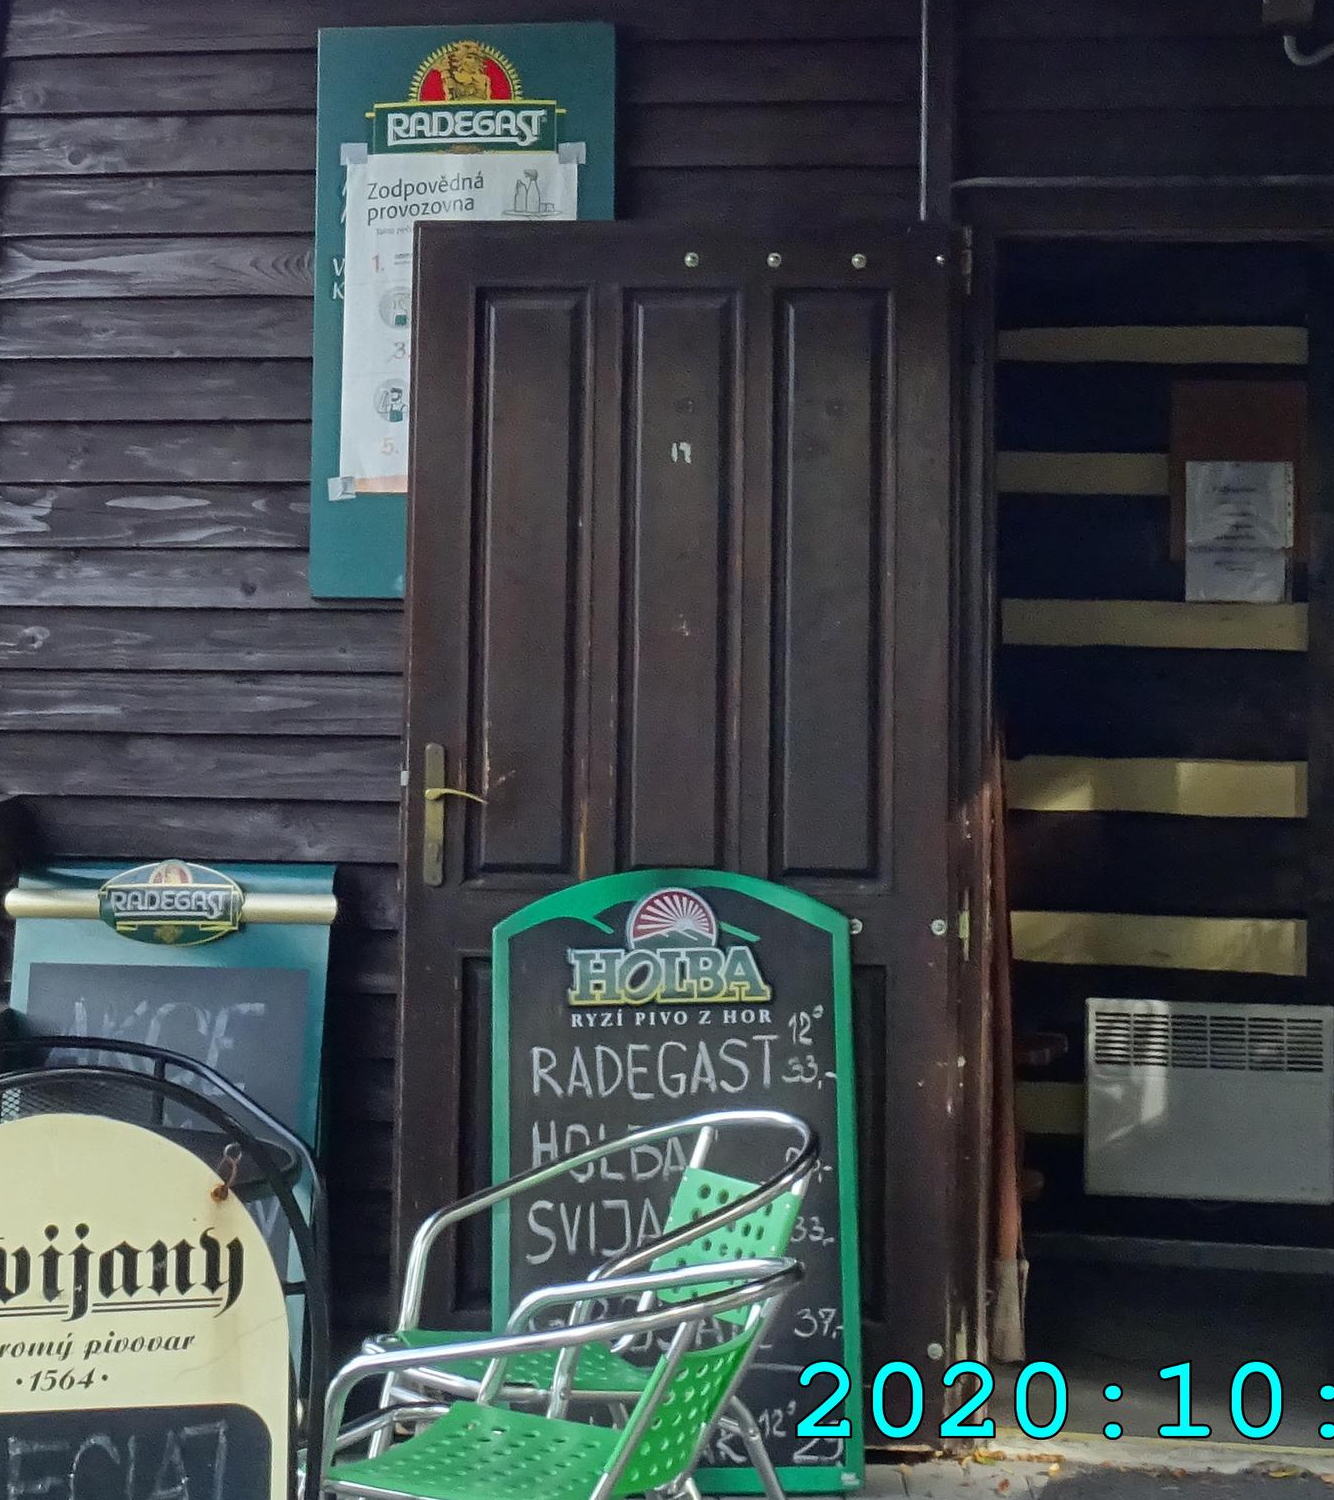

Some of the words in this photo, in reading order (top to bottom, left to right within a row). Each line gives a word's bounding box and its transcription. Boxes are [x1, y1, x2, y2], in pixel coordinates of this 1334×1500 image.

[387, 109, 546, 146] RADEGAST
[367, 171, 484, 201] Zodpovědná
[368, 197, 475, 226] provozovna
[109, 890, 230, 919] RADEGAST
[567, 945, 772, 1006] HOLBA
[571, 1008, 624, 1028] RYZÍ
[634, 1010, 689, 1027] PIVO
[698, 1010, 712, 1025] Z
[723, 1008, 772, 1025] HOR
[531, 1034, 779, 1101] RADEGAST
[525, 1196, 664, 1266] SVIJA
[83, 1332, 196, 1360] pivovar
[28, 1367, 96, 1393] 1564
